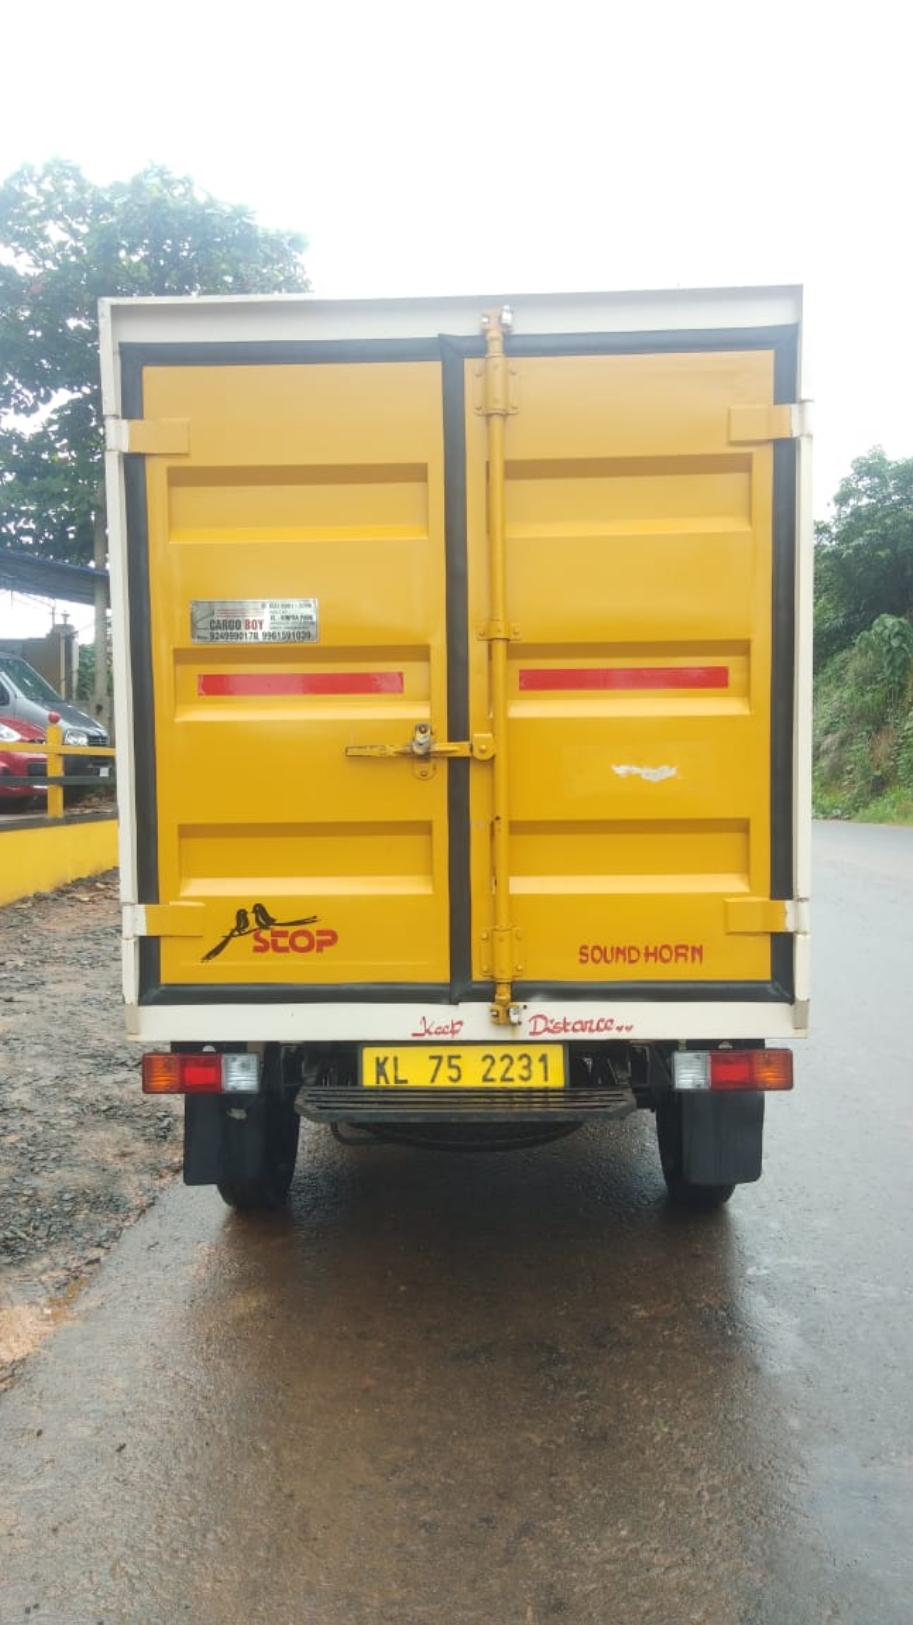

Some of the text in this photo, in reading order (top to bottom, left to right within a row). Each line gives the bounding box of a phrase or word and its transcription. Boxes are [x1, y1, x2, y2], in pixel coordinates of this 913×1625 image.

[209, 619, 264, 631] CARGO BOY
[253, 929, 339, 953] STOP
[579, 943, 704, 964] SOUND HORN
[411, 1016, 464, 1039] Keep
[375, 1053, 549, 1084] KL 75 2231
